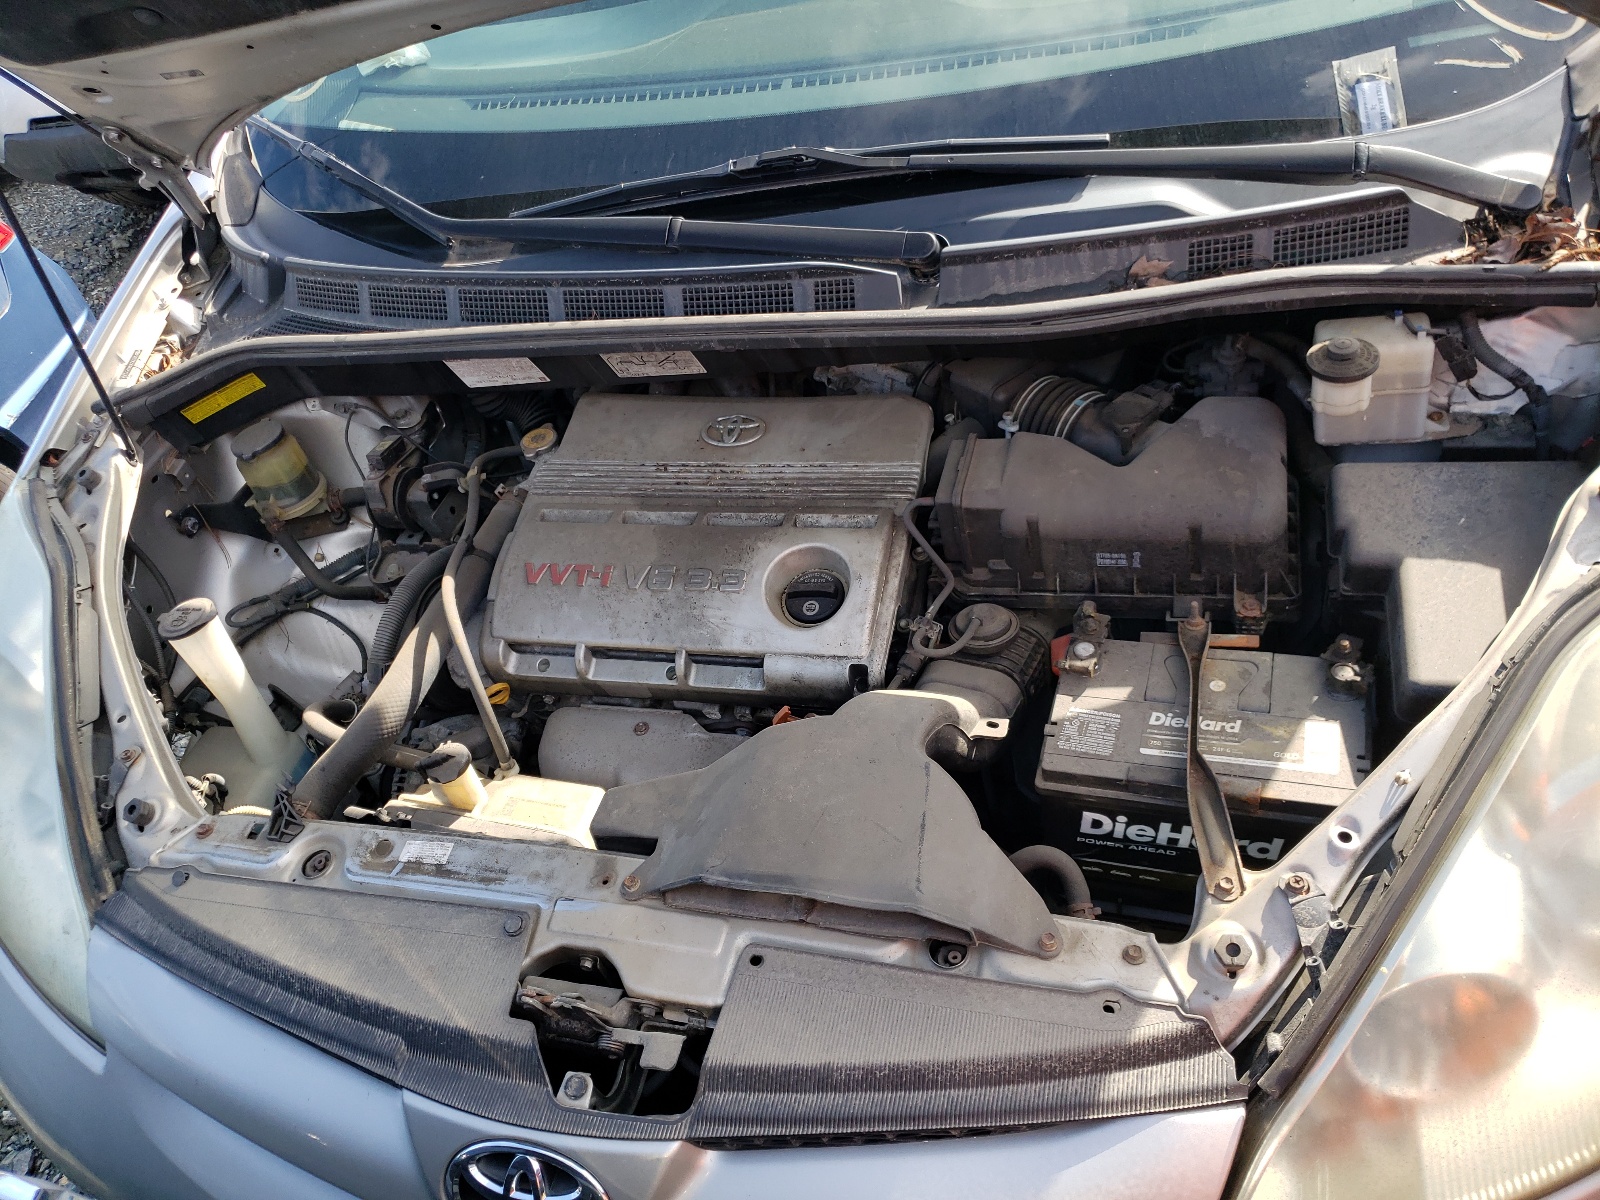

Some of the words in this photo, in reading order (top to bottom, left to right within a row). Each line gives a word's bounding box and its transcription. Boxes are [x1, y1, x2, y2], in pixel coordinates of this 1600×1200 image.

[625, 564, 677, 591] V6
[684, 567, 748, 594] 3.3
[1076, 836, 1124, 849] POWER
[1128, 844, 1177, 856] AHEAD
[1079, 811, 1285, 861] DieHd
